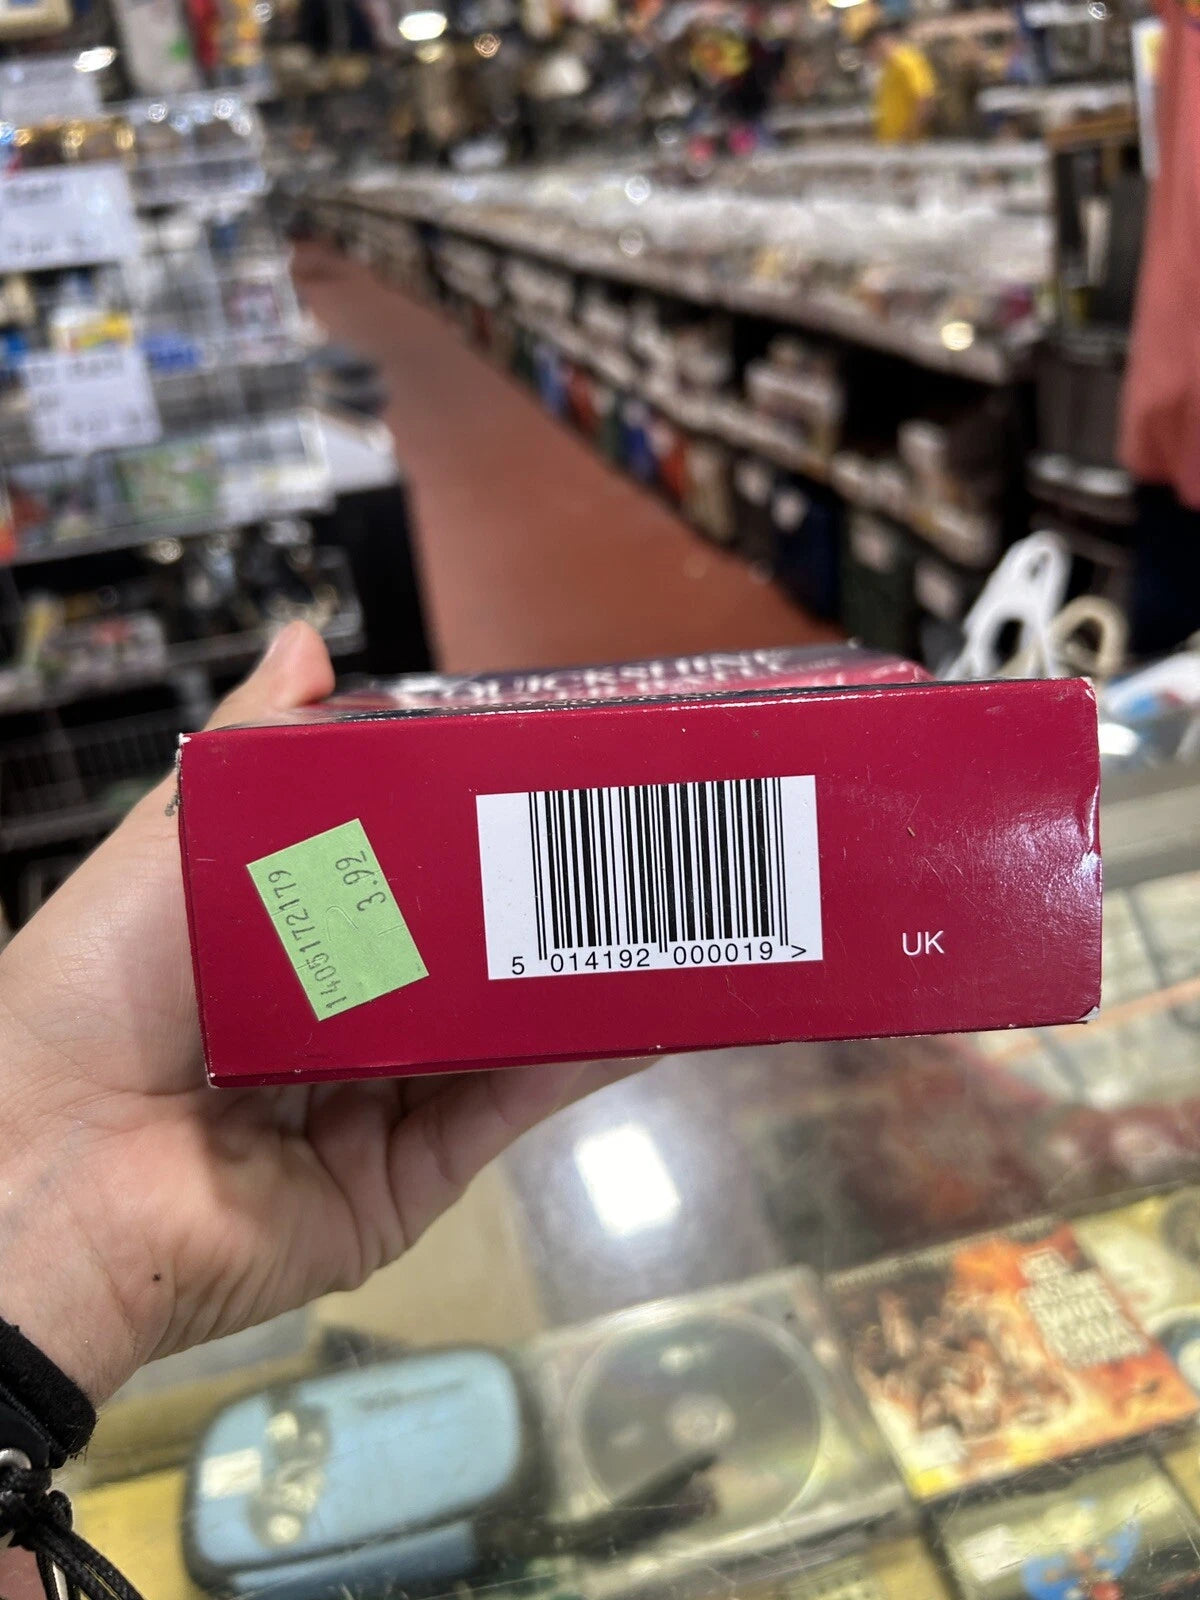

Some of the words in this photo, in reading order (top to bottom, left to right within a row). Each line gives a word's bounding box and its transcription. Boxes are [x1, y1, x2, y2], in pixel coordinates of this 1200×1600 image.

[267, 869, 348, 1009] 1405172179
[902, 930, 945, 956] UK
[511, 955, 525, 977] 5
[550, 948, 651, 974] 014192
[673, 941, 774, 966] 000019
